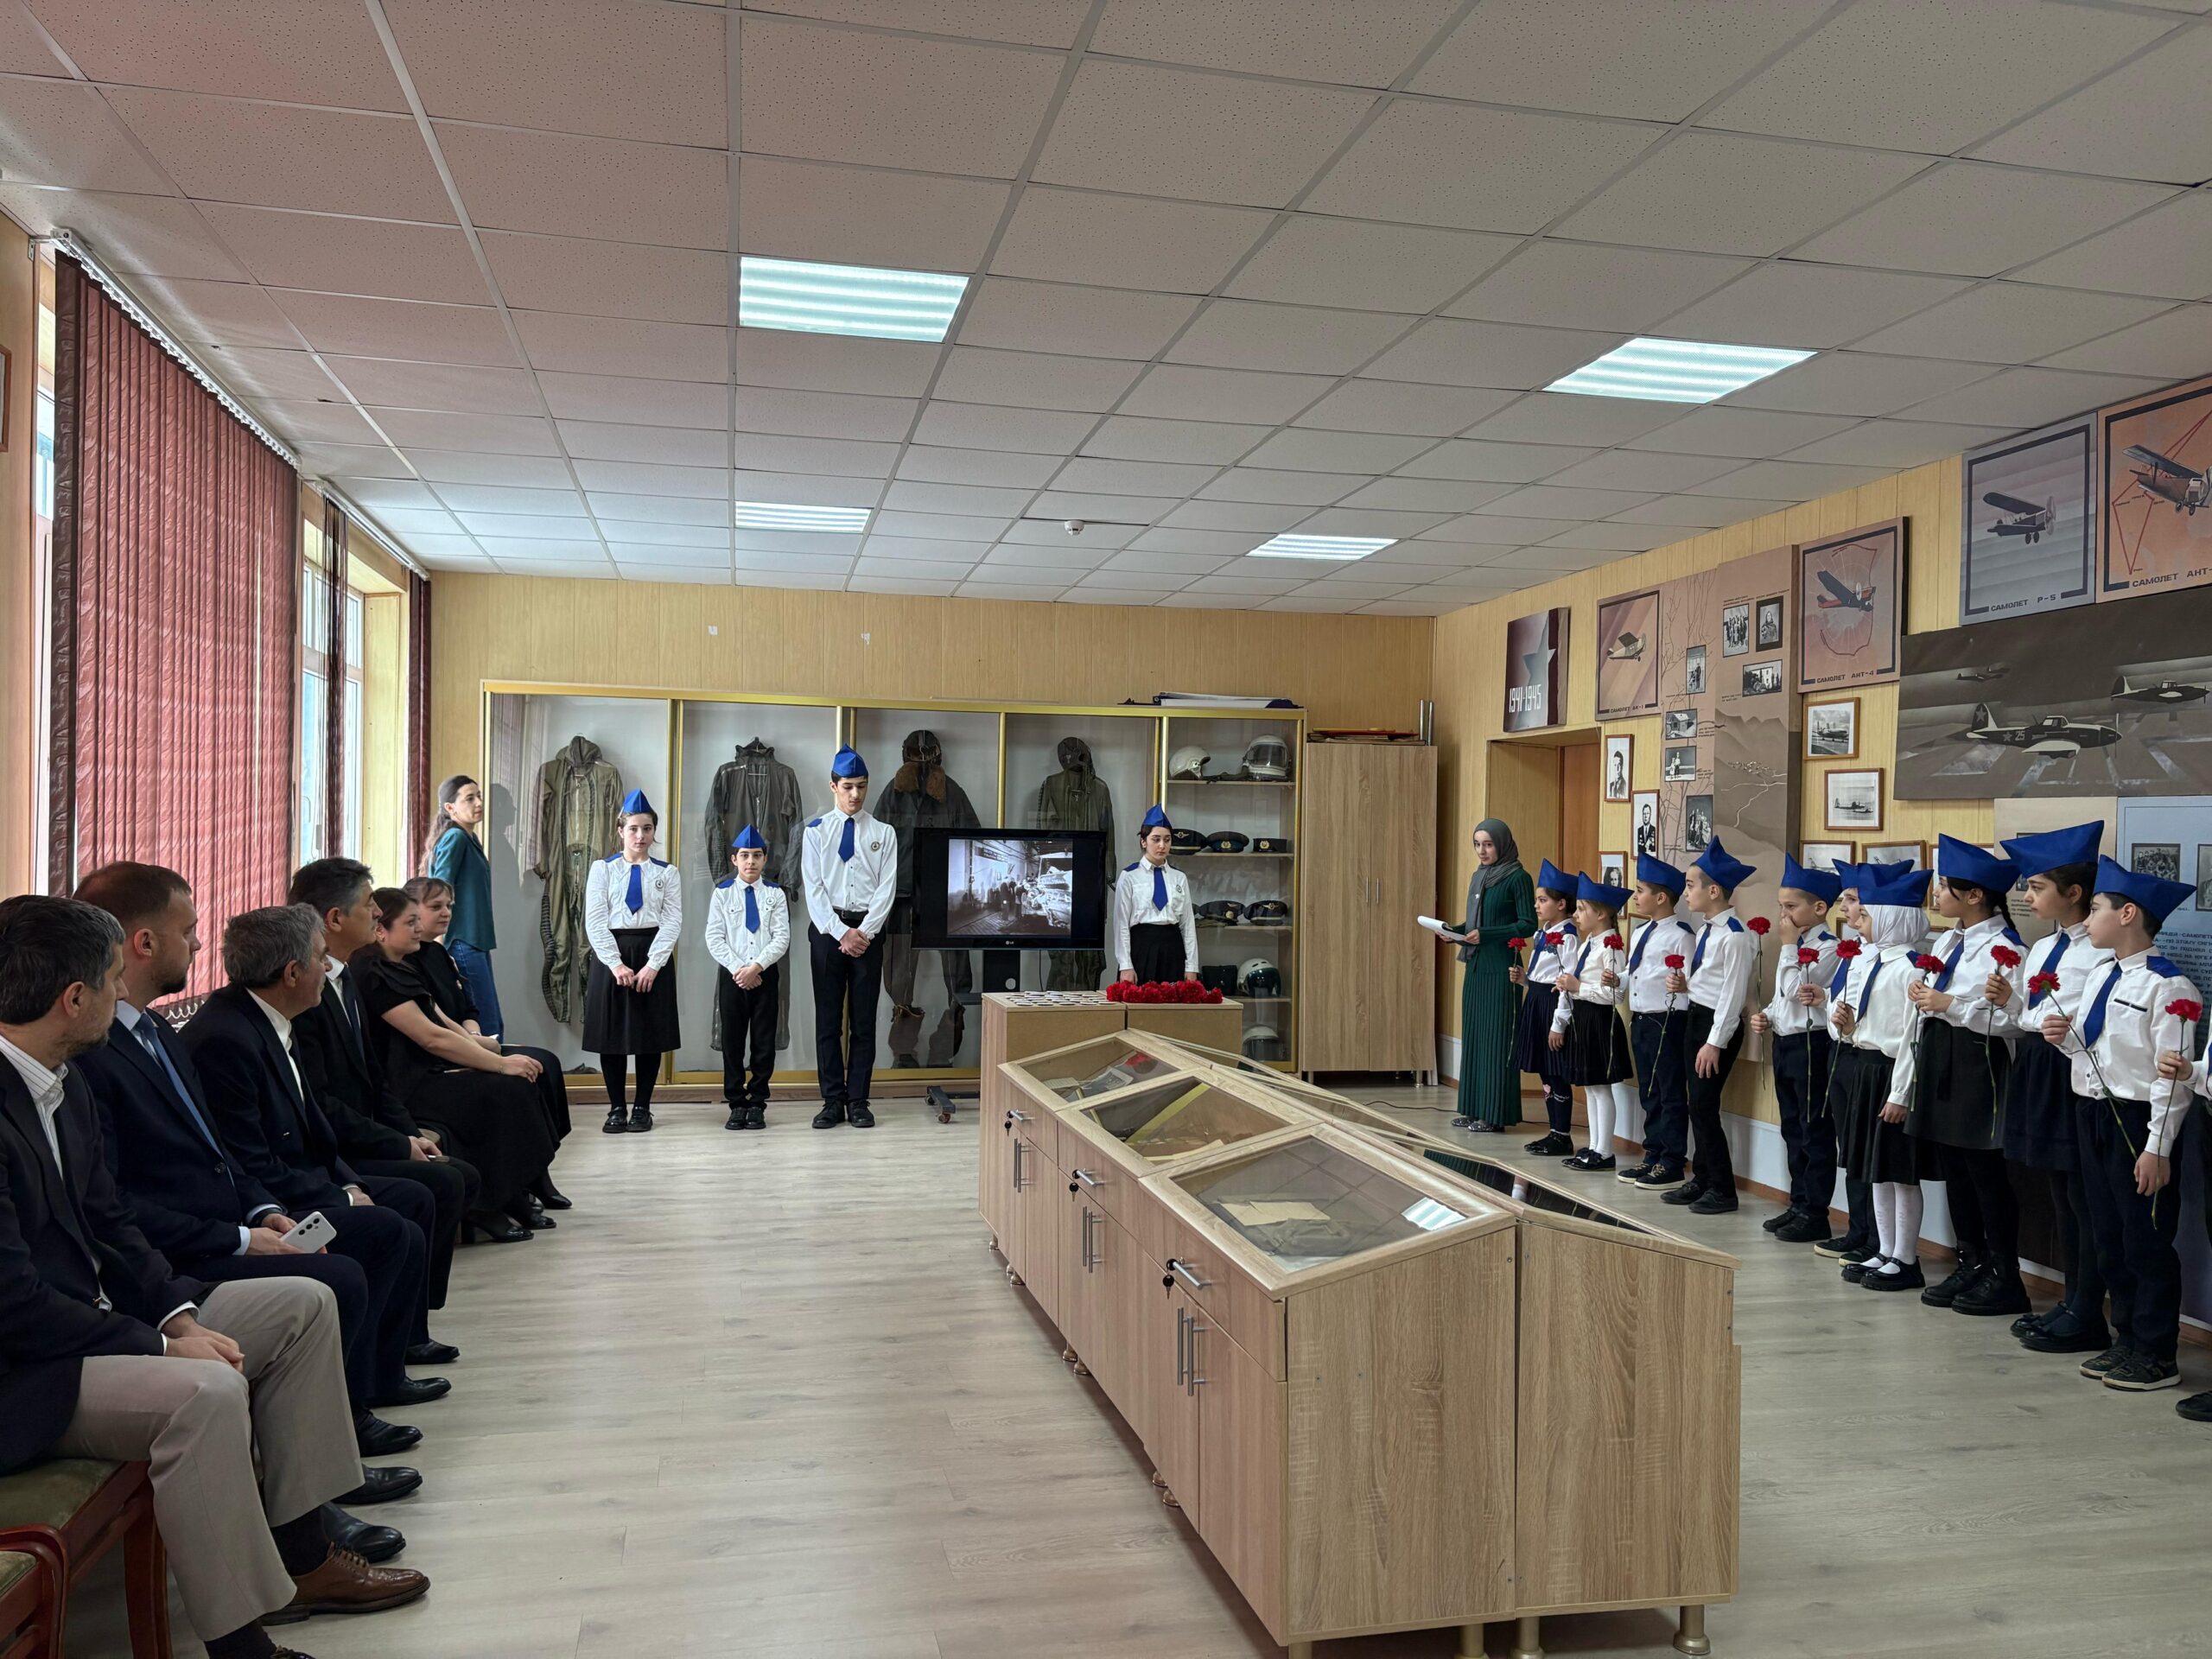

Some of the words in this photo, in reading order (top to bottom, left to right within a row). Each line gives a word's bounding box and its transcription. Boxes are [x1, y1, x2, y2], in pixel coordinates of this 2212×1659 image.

[2132, 573, 2178, 588] САМОЛЕТ
[1991, 599, 2029, 612] САМОЛЕТ
[1816, 674, 1846, 683] САМОЛЕТ
[1851, 670, 1874, 679] АНТ-4
[1509, 683, 1541, 713] 1941-1945
[2014, 730, 2025, 741] 25
